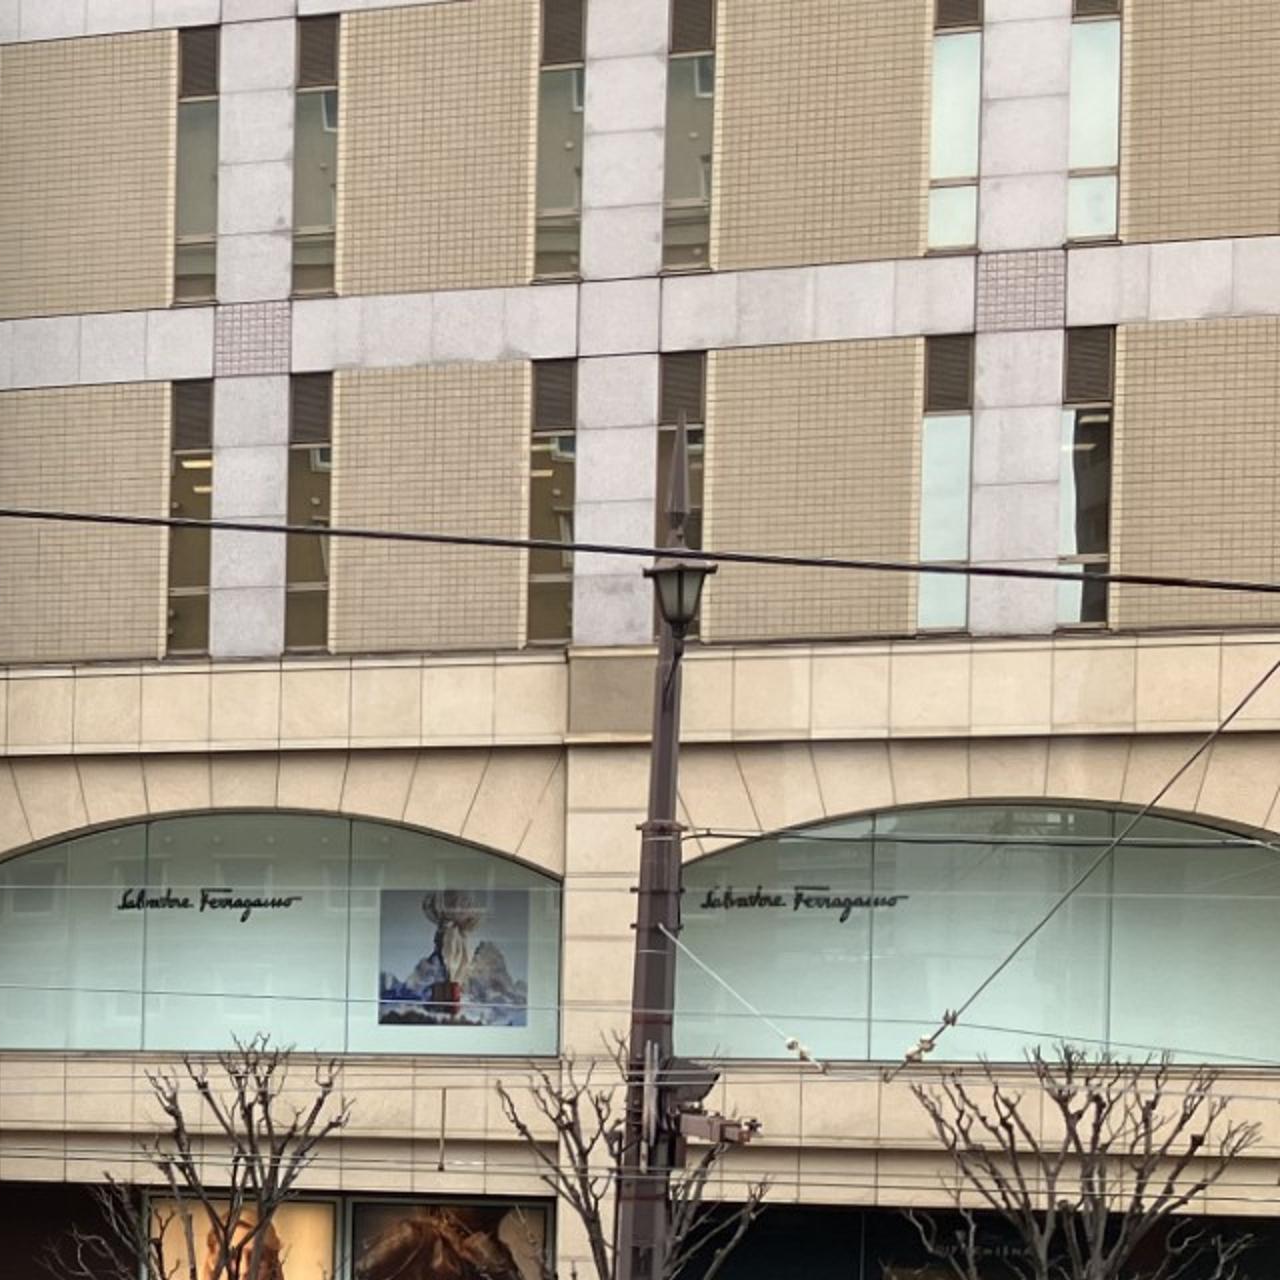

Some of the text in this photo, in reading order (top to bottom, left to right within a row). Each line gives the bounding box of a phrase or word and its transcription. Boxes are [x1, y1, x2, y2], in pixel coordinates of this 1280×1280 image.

[117, 887, 303, 923] Salvatore Ferragamo
[700, 885, 909, 923] Salvatore Ferragamo
